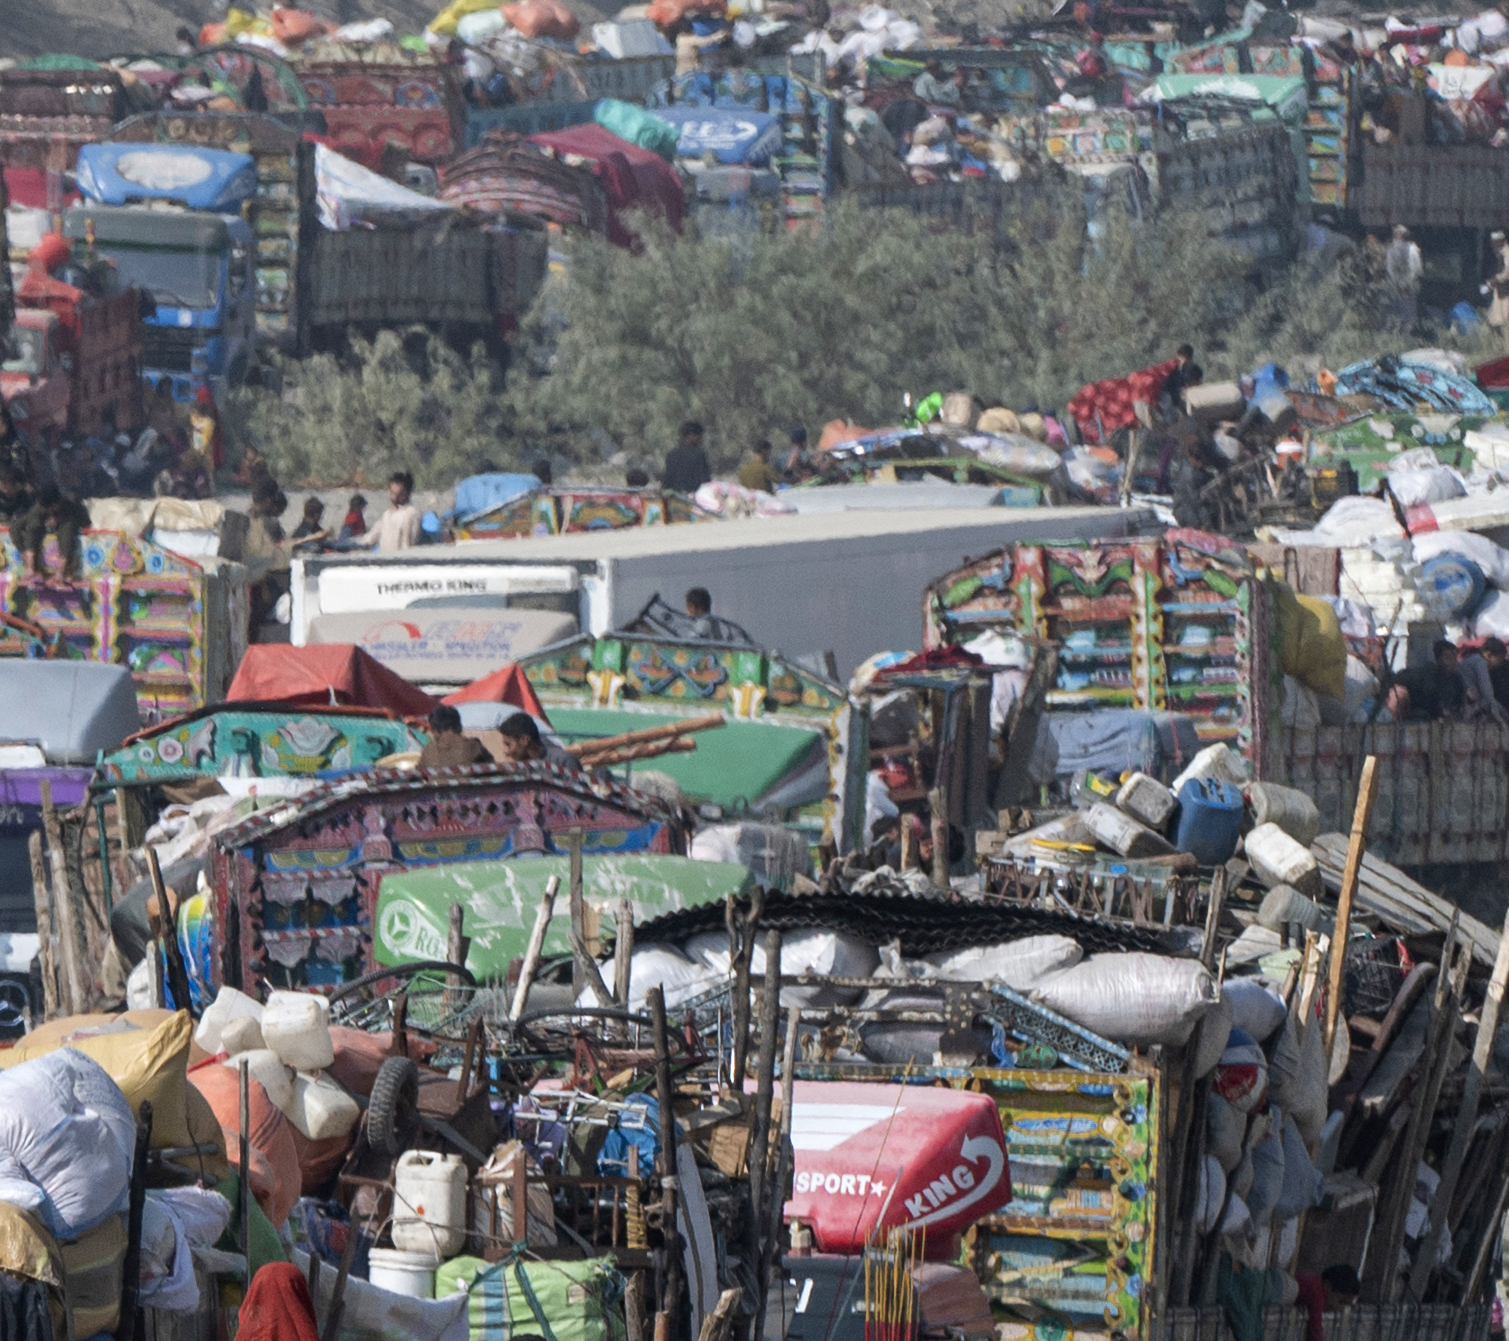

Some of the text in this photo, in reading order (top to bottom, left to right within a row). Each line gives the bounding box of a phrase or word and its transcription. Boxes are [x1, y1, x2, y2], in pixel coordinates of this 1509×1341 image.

[377, 579, 487, 594] THERMO KING
[904, 1164, 977, 1218] KING
